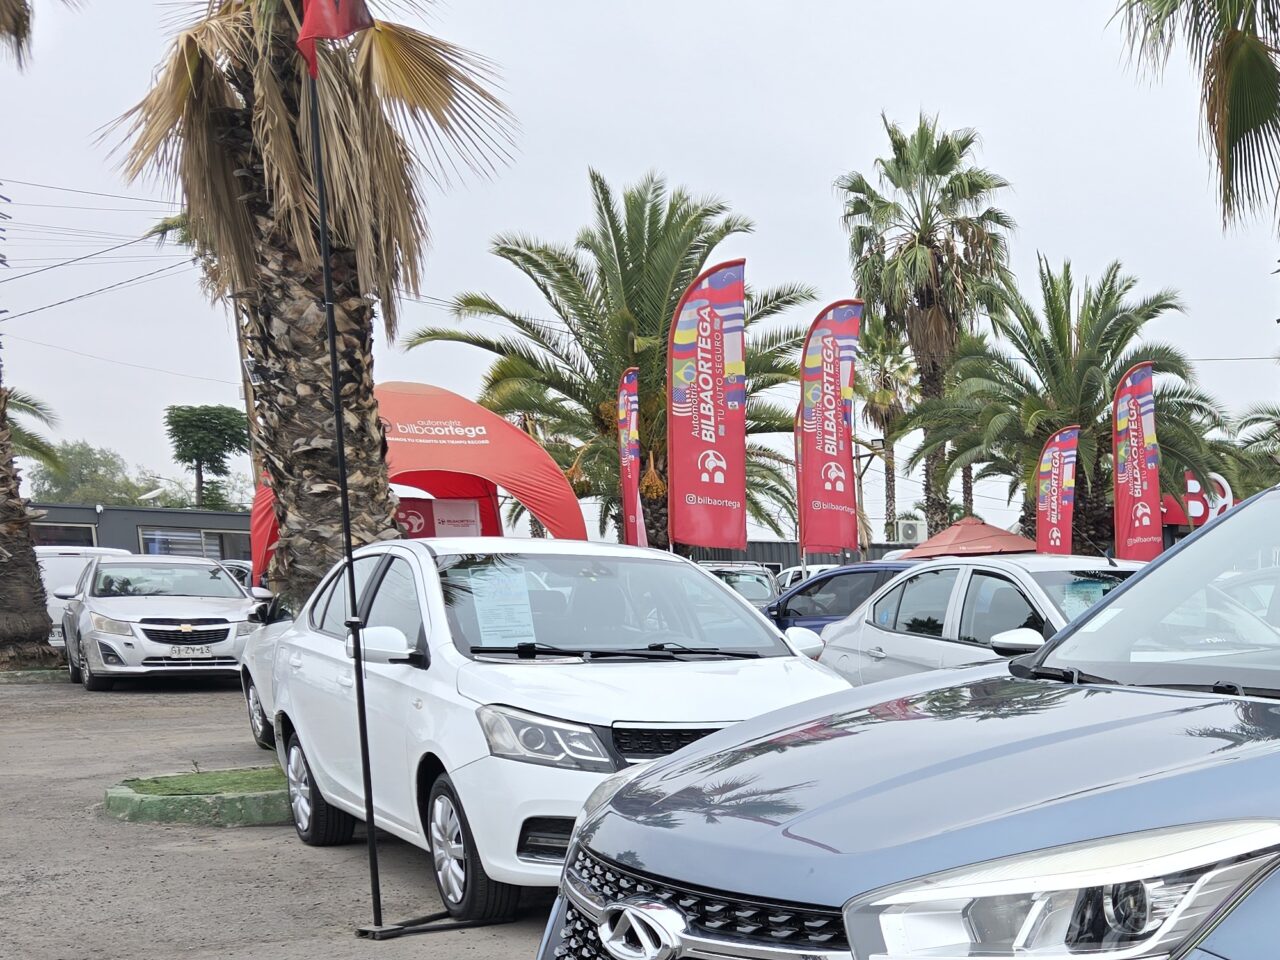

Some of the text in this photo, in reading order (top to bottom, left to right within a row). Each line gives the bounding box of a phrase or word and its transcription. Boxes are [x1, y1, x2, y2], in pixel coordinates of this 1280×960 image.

[696, 306, 716, 443] BILBAORTEGA
[715, 332, 723, 374] SEGURO
[691, 382, 700, 438] Automotriz
[717, 409, 725, 421] TU
[822, 336, 837, 456] BILBAORTEGA
[396, 422, 487, 437] bilbaortega
[815, 402, 823, 451] Automotriz
[697, 496, 741, 508] bilbaortega
[1050, 450, 1061, 525] BILBAORTEGA
